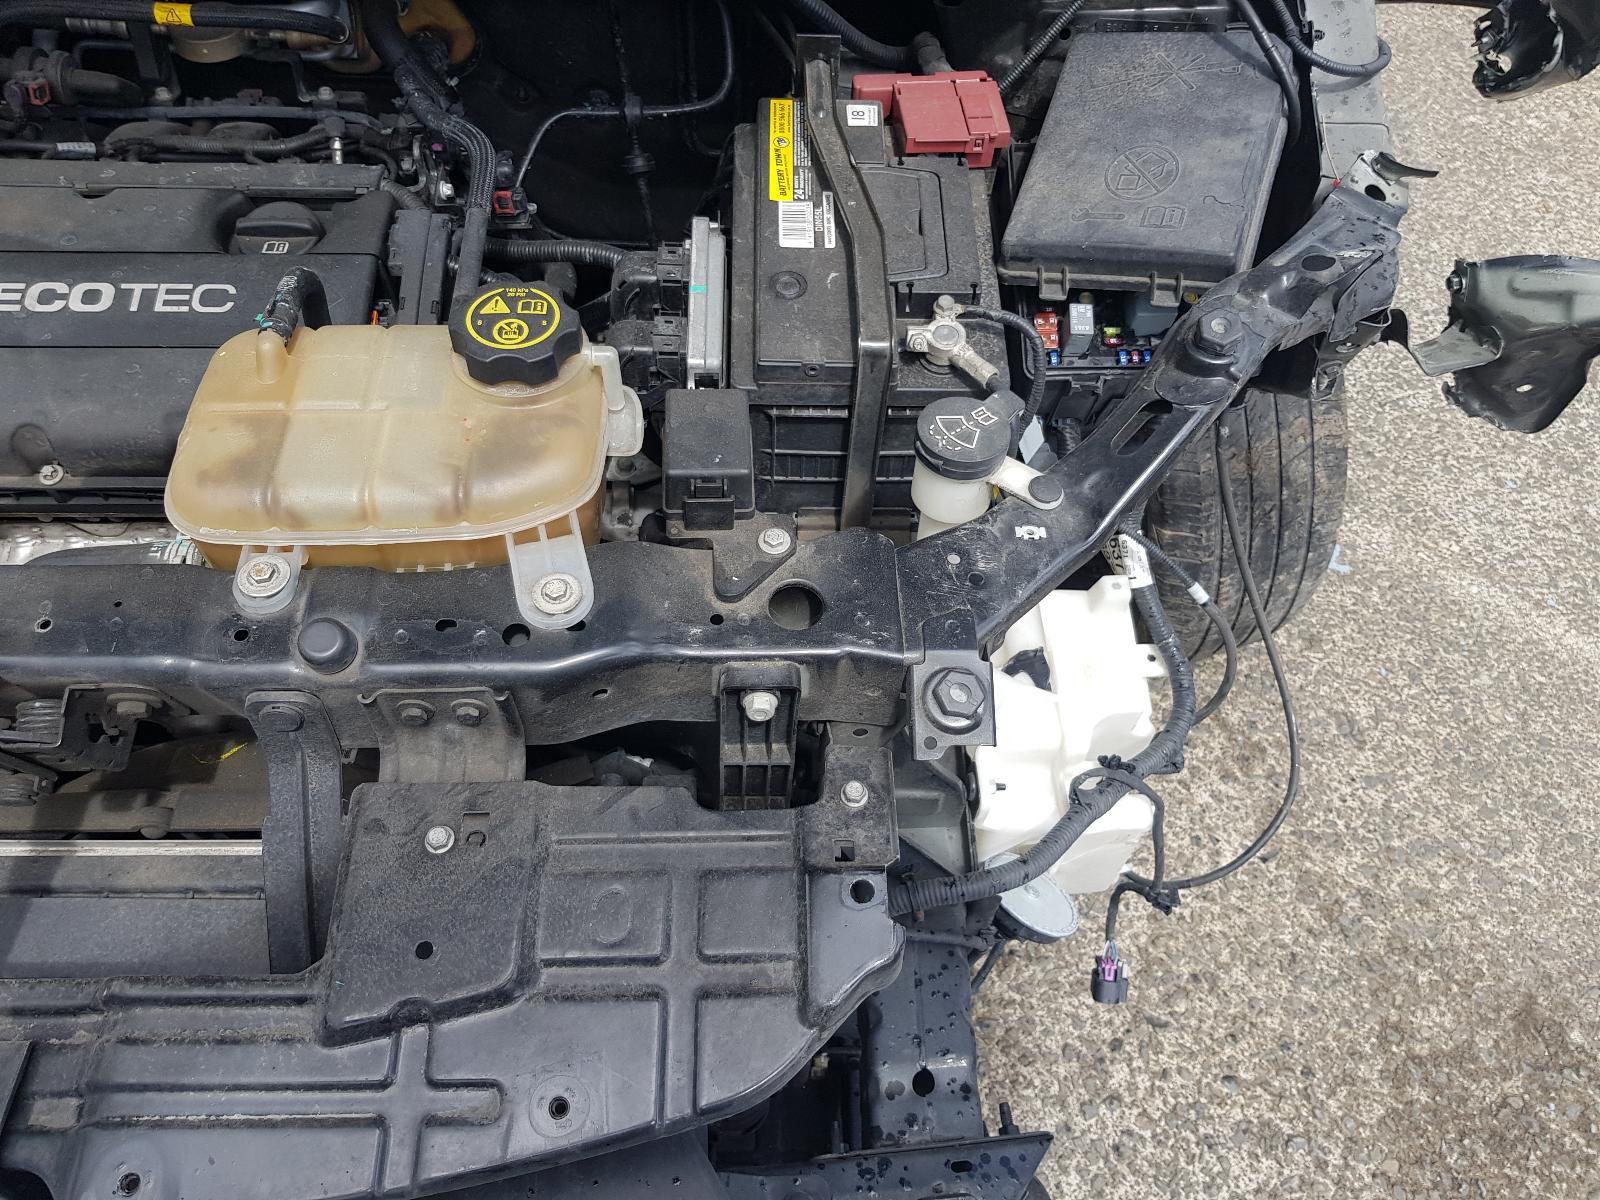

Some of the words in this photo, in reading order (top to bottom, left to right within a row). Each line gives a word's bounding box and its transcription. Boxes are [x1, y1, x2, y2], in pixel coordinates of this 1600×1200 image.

[852, 110, 865, 120] 18
[774, 147, 783, 166] TOWN
[776, 169, 788, 196] BATTERY
[794, 189, 804, 200] 24
[0, 282, 238, 313] ECOTEC
